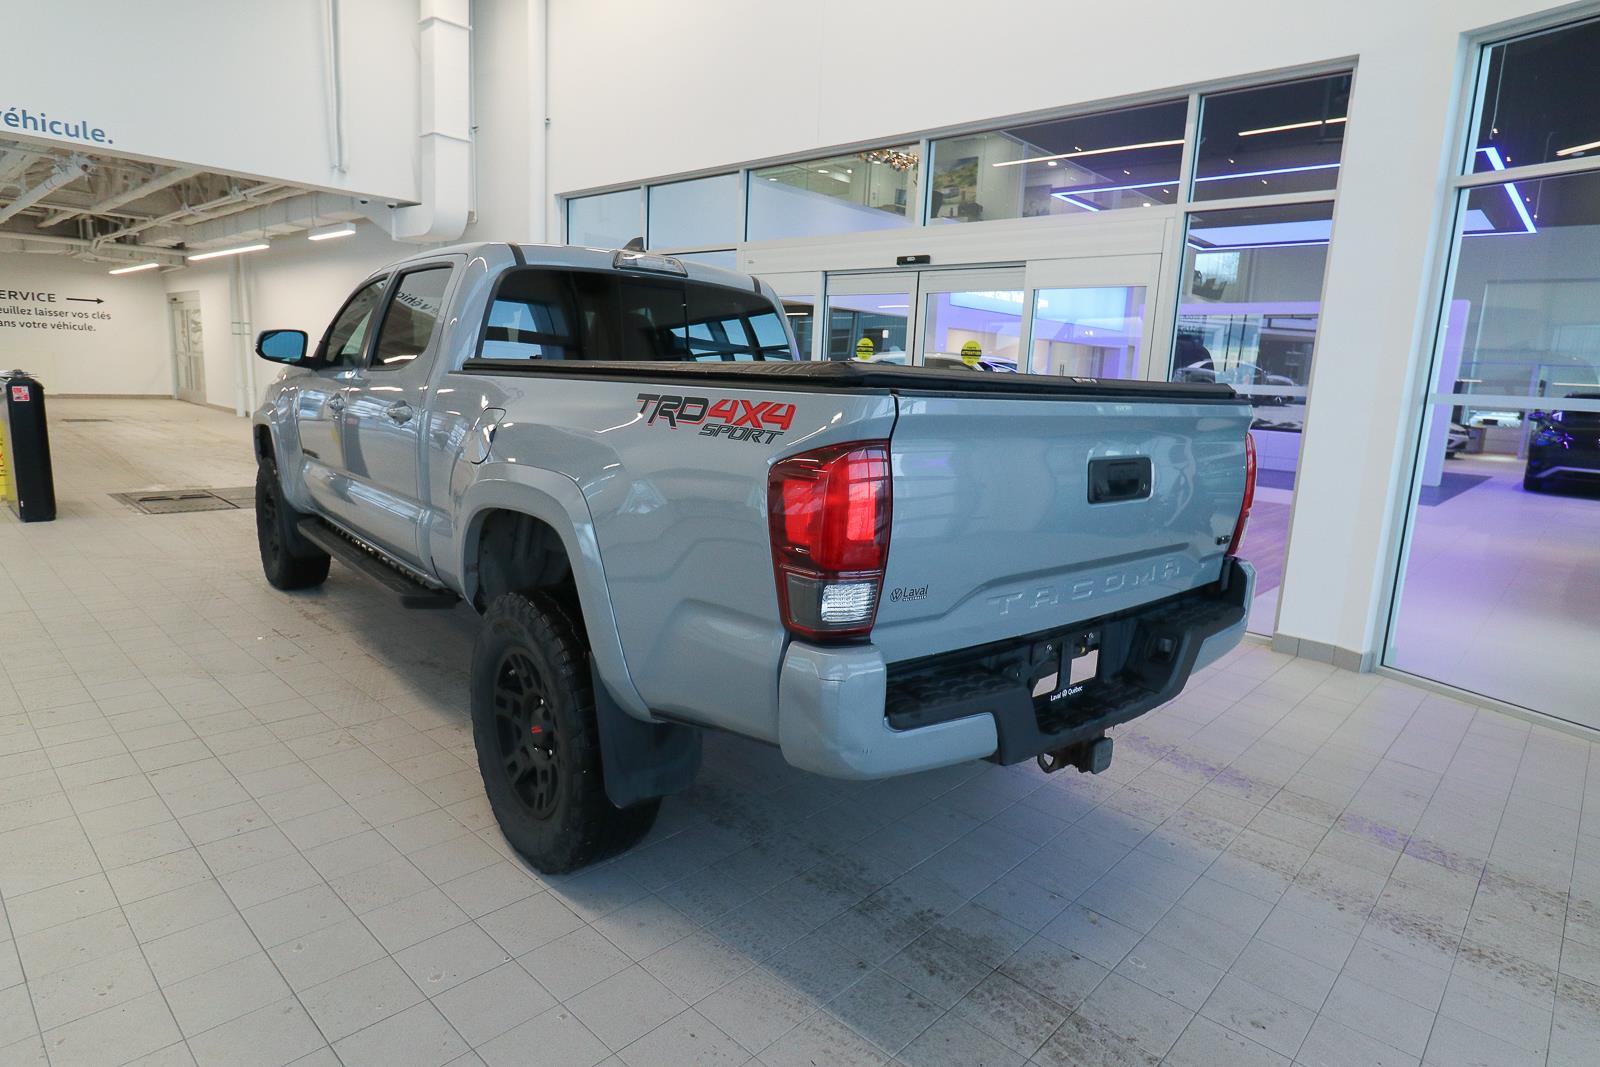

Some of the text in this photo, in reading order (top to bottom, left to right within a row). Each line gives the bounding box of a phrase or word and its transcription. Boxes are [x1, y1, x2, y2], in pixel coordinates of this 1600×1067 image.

[0, 107, 113, 144] éhicule.
[35, 307, 69, 318] laisser
[92, 311, 111, 320] clés
[19, 320, 47, 329] votre
[51, 321, 96, 331] véhicule.
[637, 393, 709, 430] TRD
[698, 423, 784, 445] SPORT
[903, 584, 928, 597] Laval
[985, 557, 1182, 616] TACOMA
